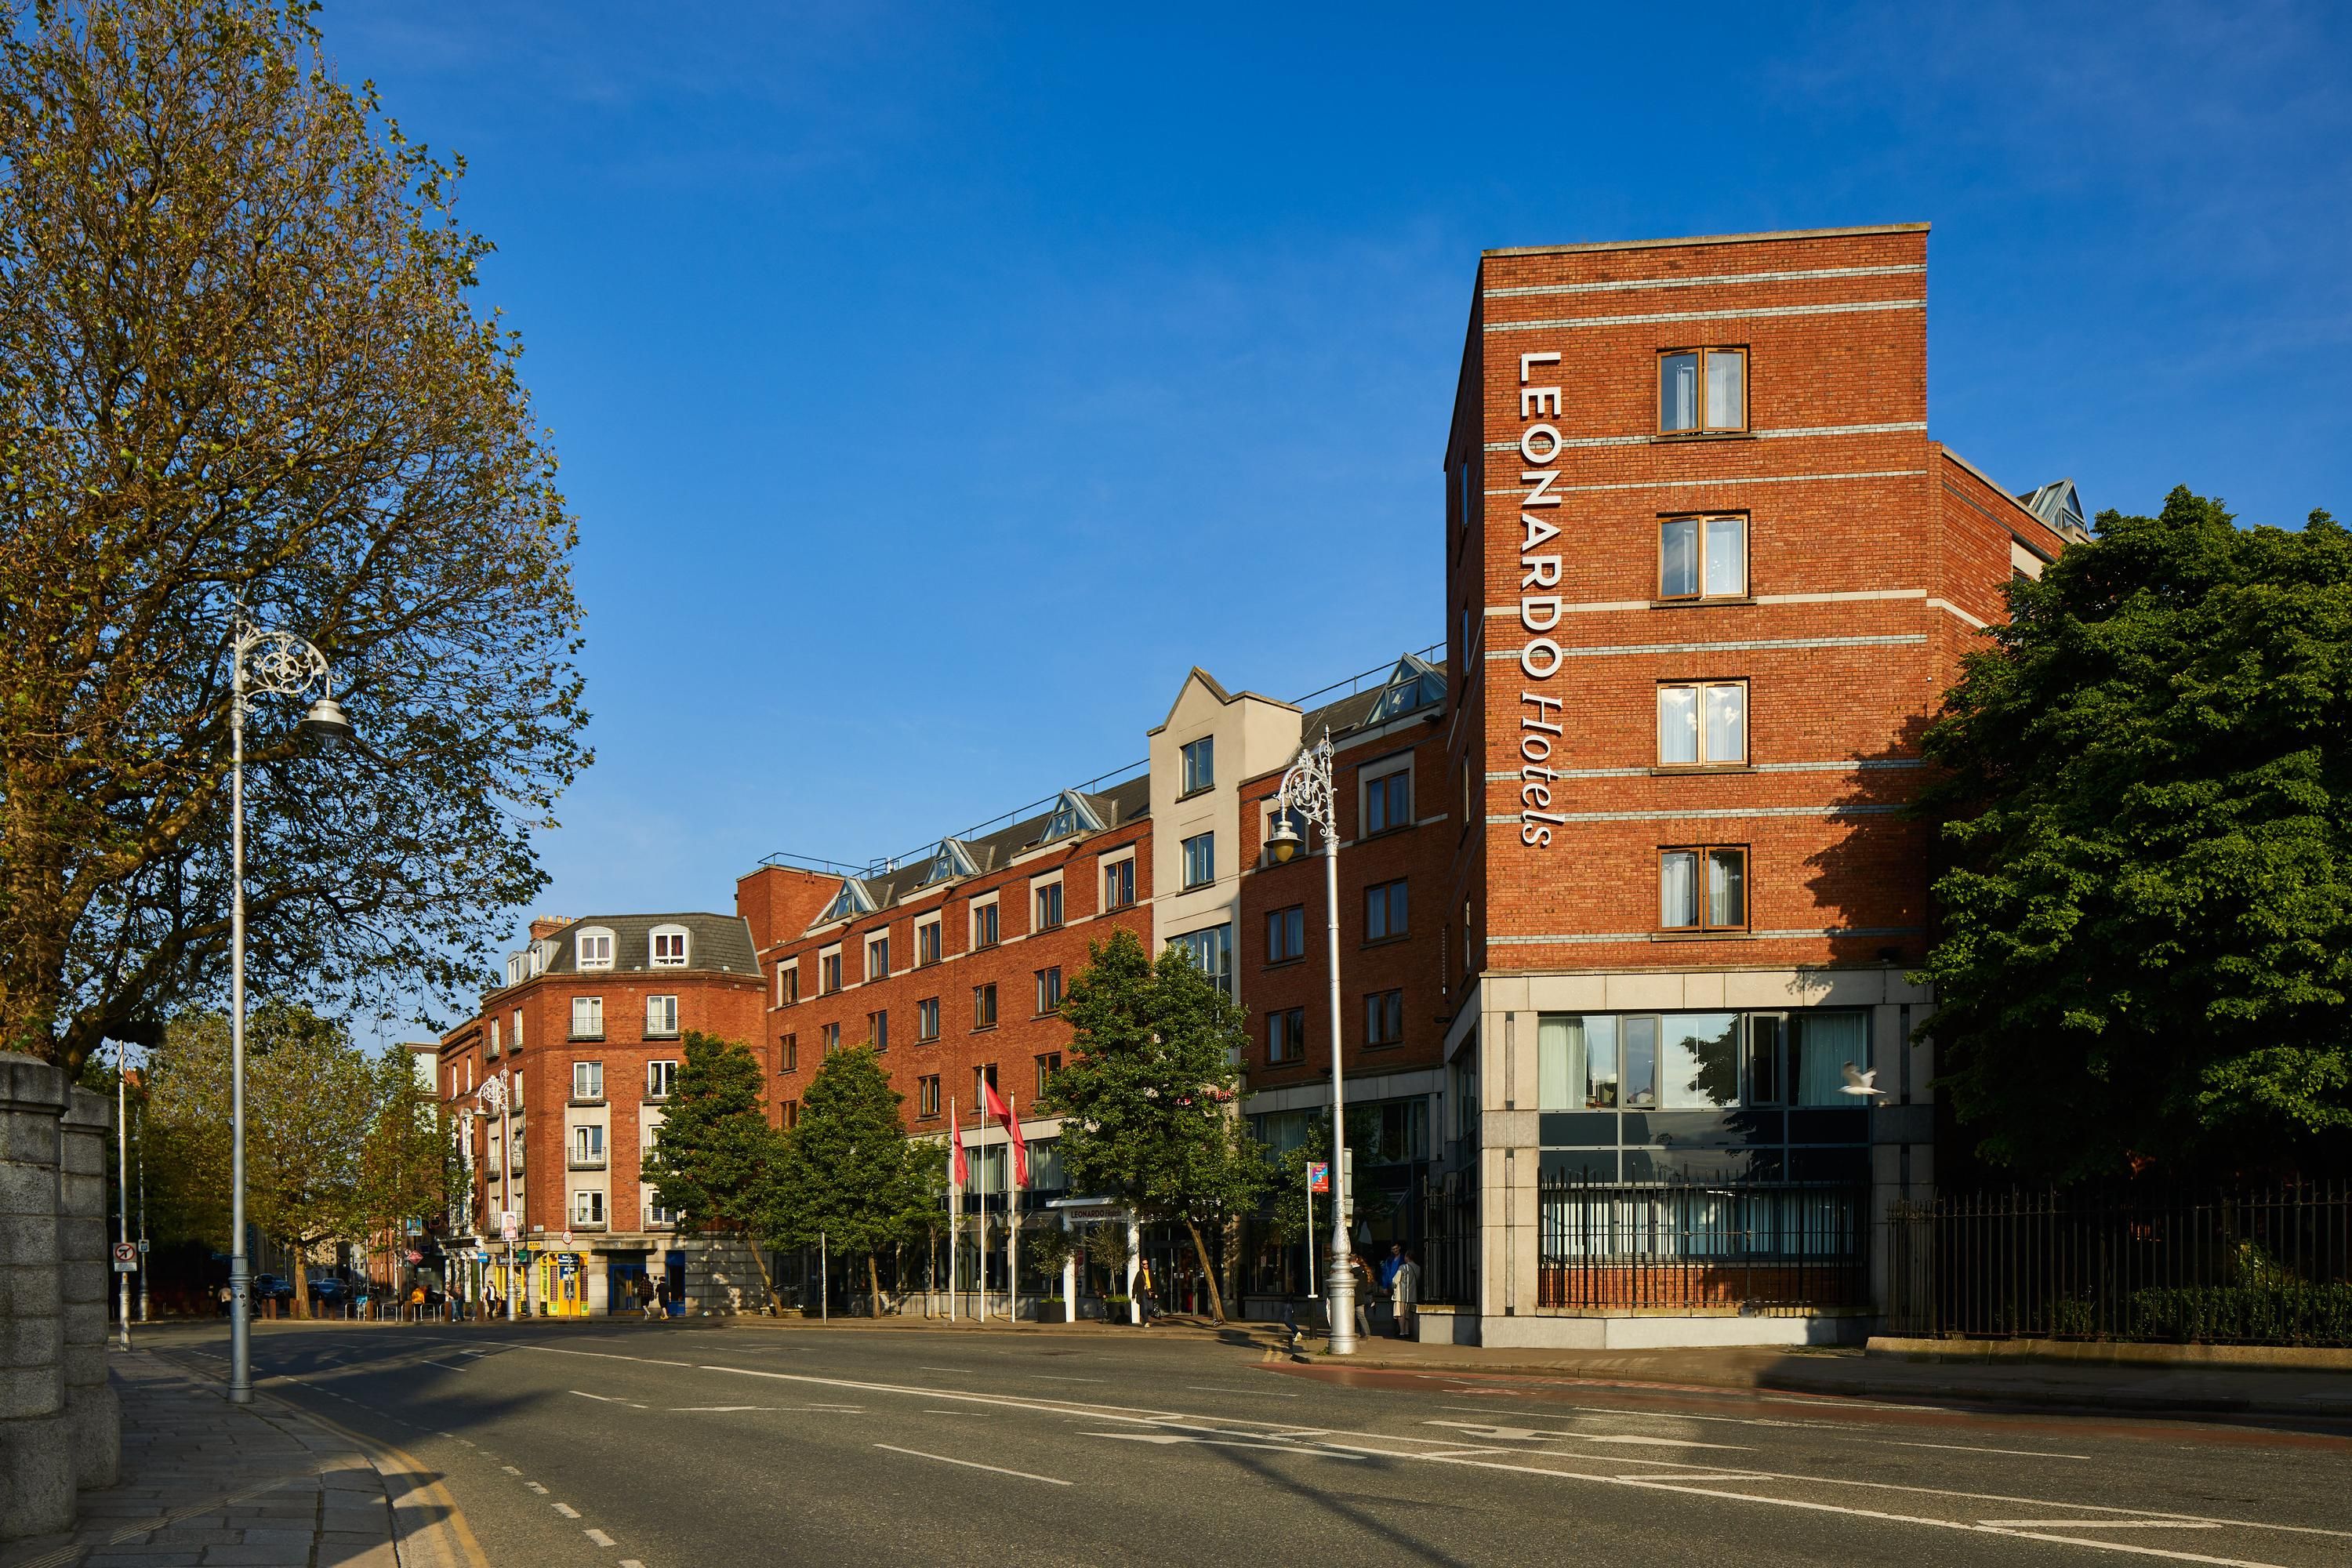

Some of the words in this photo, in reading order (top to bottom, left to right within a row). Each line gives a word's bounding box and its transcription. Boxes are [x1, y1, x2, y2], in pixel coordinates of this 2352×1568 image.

[1521, 352, 1563, 677] LEONARDO
[1522, 690, 1566, 847] Hotels
[1071, 1210, 1105, 1218] LEONARDO
[1105, 1209, 1122, 1218] Hotels
